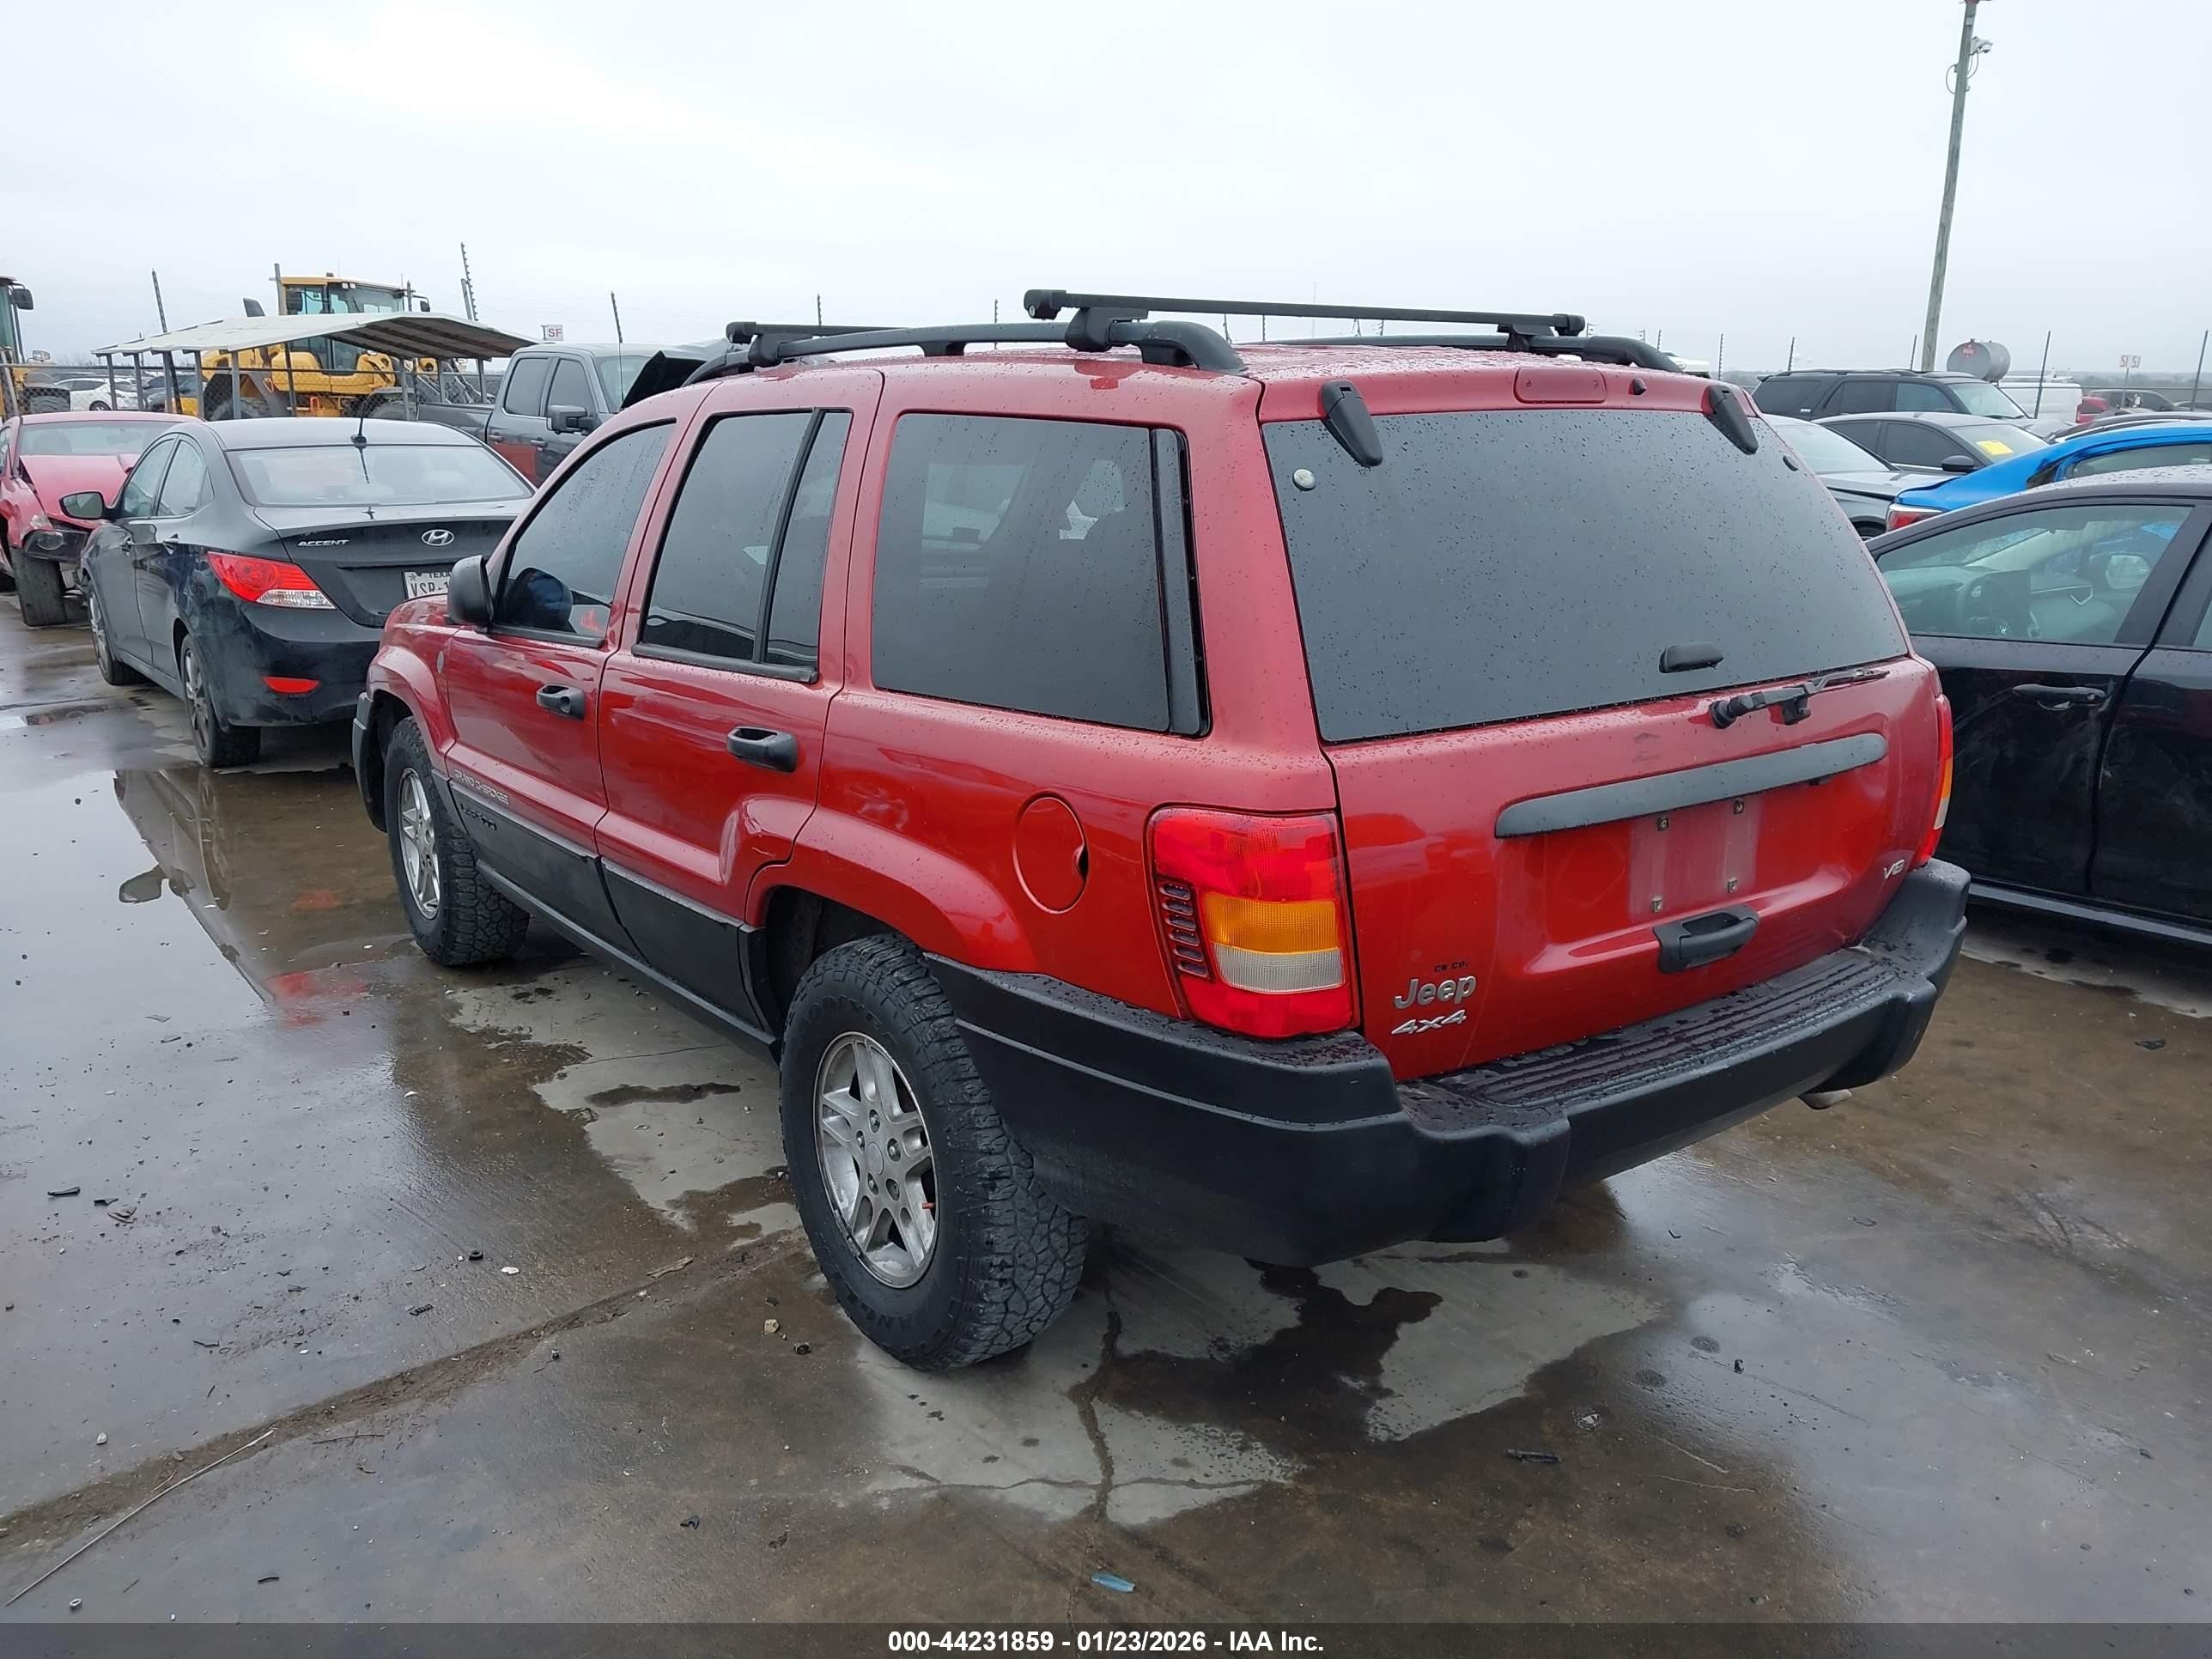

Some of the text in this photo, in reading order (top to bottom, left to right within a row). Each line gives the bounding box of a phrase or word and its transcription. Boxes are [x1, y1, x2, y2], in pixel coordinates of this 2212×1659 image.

[548, 328, 562, 337] SF
[1883, 859, 1905, 880] V8
[1394, 975, 1477, 1009] Jeep
